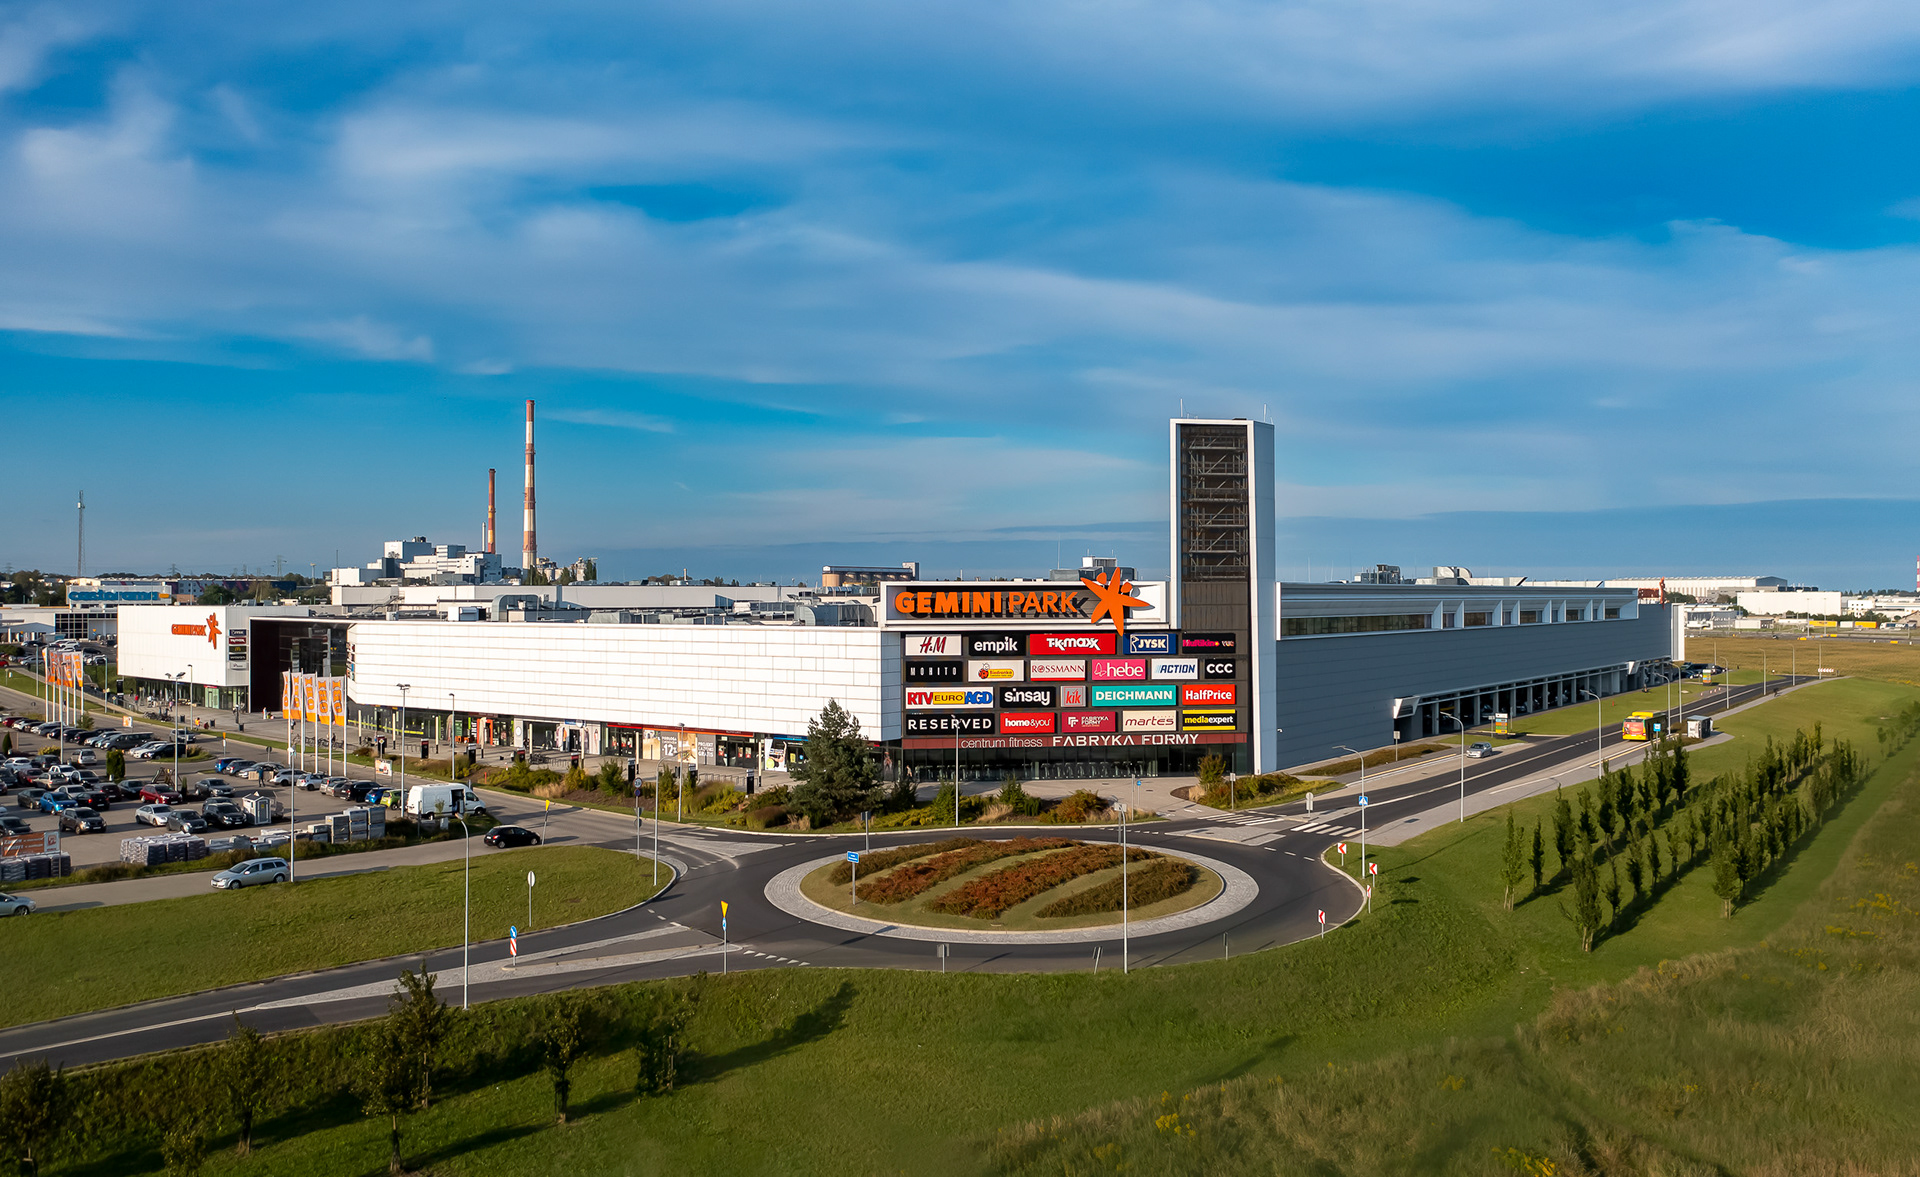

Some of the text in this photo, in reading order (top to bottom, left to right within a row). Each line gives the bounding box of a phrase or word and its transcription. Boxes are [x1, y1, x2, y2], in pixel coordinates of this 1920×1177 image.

[895, 591, 1078, 613] GEMINI PARK
[919, 636, 947, 654] H&M
[974, 636, 1018, 653] empik
[1138, 639, 1166, 649] JYSK
[910, 667, 957, 676] MOHITO
[1032, 665, 1085, 673] ROSSMANN
[1107, 662, 1144, 677] hebe
[1160, 665, 1195, 673] ACTION
[1206, 663, 1233, 674] CCC
[907, 691, 993, 705] RTV EURO AGD
[1004, 688, 1050, 706] sinsay
[1095, 691, 1172, 701] DEICHMANN
[1185, 690, 1232, 700] HalfPrice
[908, 718, 992, 730] RESERVED
[1125, 716, 1174, 726] martes
[960, 733, 1199, 749] centrum fitness FABRYKA FORMY
